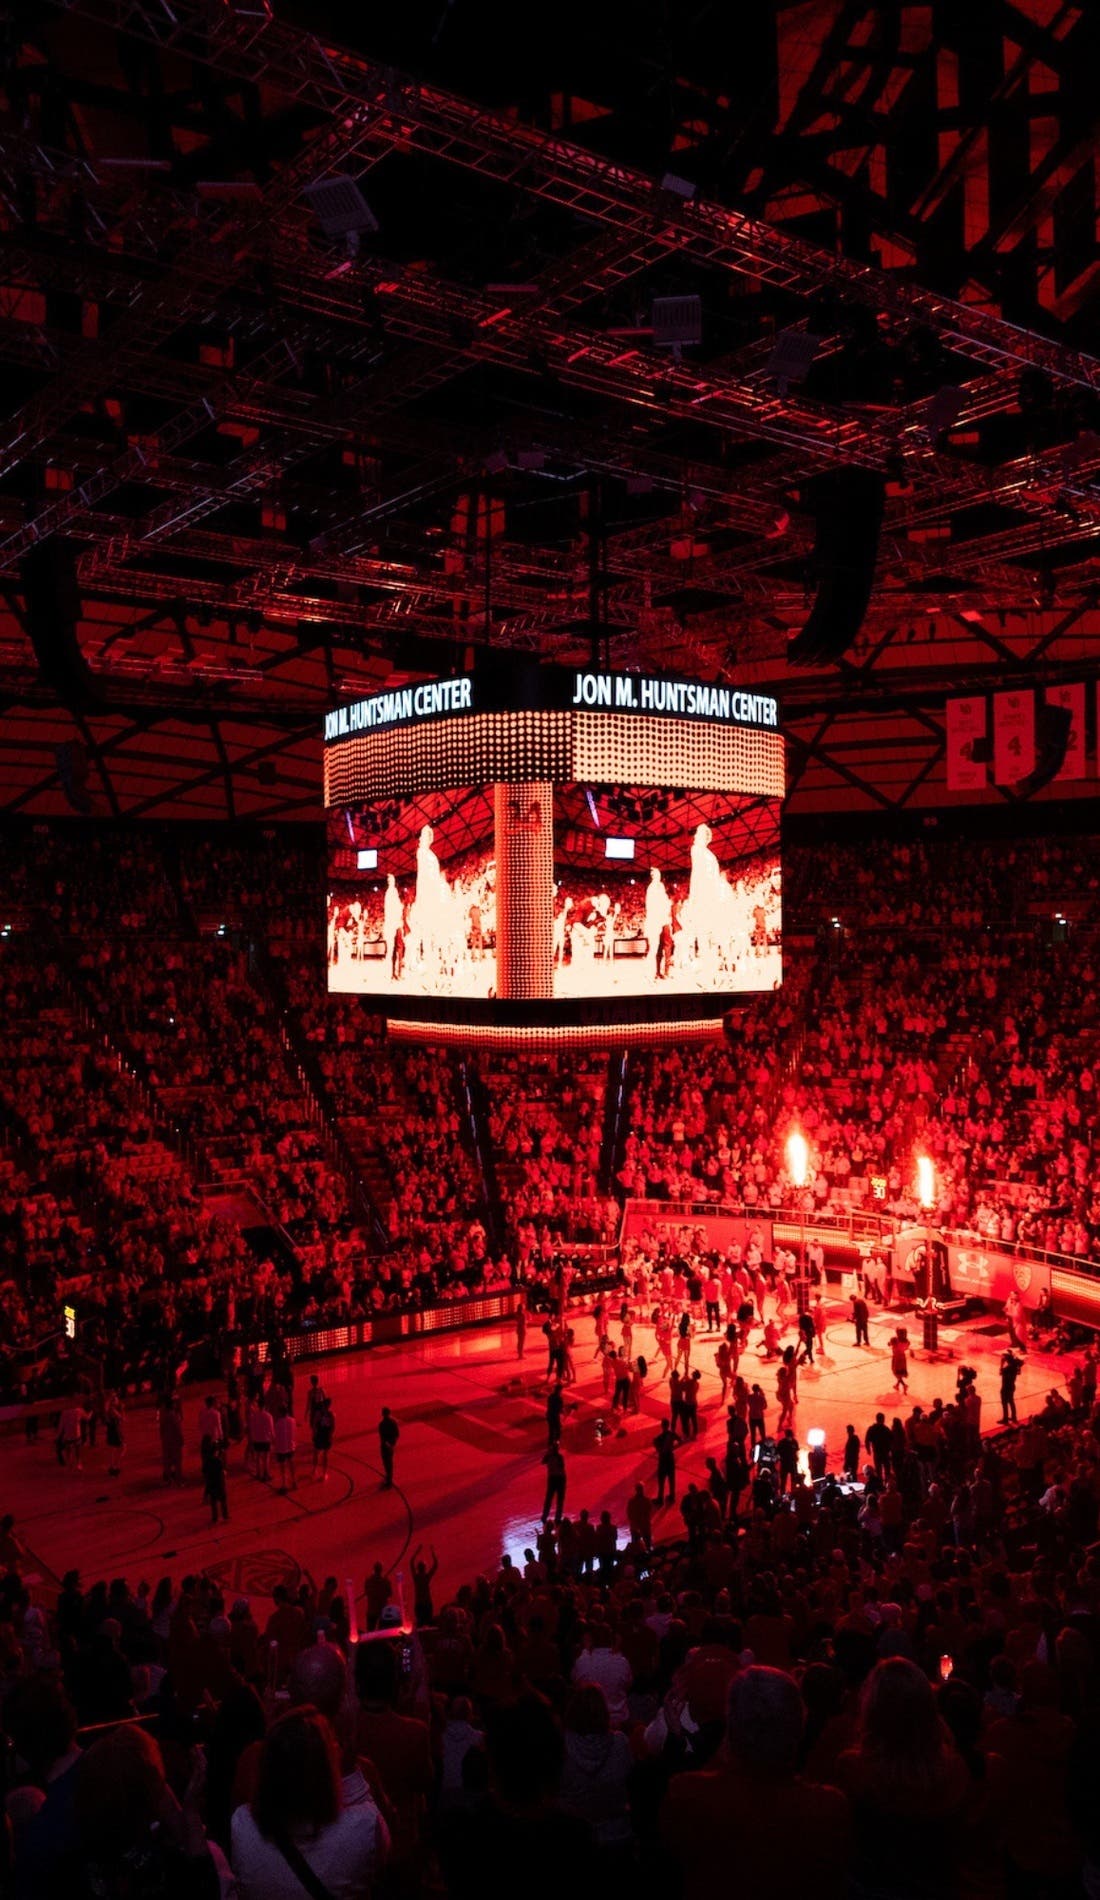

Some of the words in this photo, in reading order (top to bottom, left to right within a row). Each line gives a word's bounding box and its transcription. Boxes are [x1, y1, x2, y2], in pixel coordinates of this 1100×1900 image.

[350, 689, 413, 732] HUNTSMAN
[414, 678, 472, 716] CENTER
[573, 674, 612, 706] JON
[615, 677, 638, 707] M.
[641, 680, 730, 718] HUNTSMAN
[732, 692, 778, 726] CENTER
[1007, 735, 1022, 757] 4
[873, 1187, 886, 1199] 30
